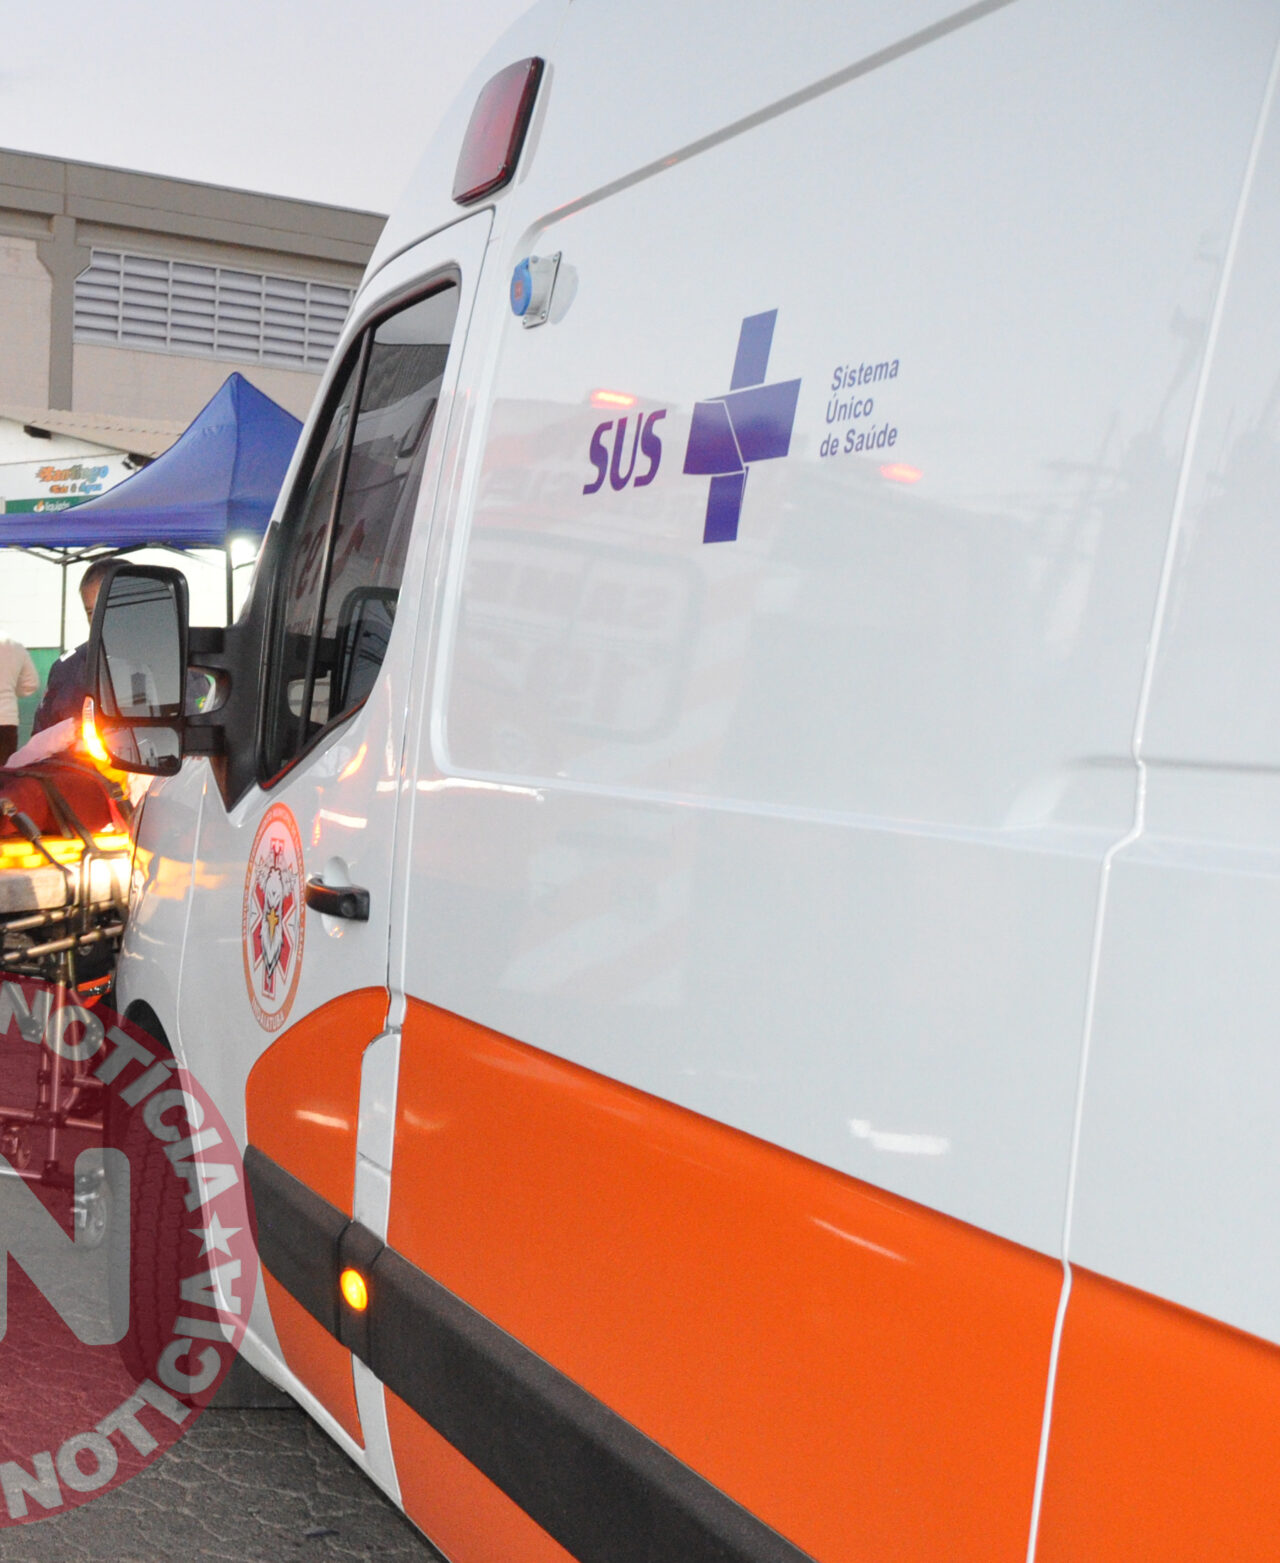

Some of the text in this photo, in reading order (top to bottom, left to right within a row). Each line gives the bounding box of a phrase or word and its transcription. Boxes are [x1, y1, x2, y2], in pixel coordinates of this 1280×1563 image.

[831, 359, 900, 391] Sistema
[826, 392, 874, 424] Único
[582, 408, 667, 495] SUS
[820, 422, 898, 457] de Saúde
